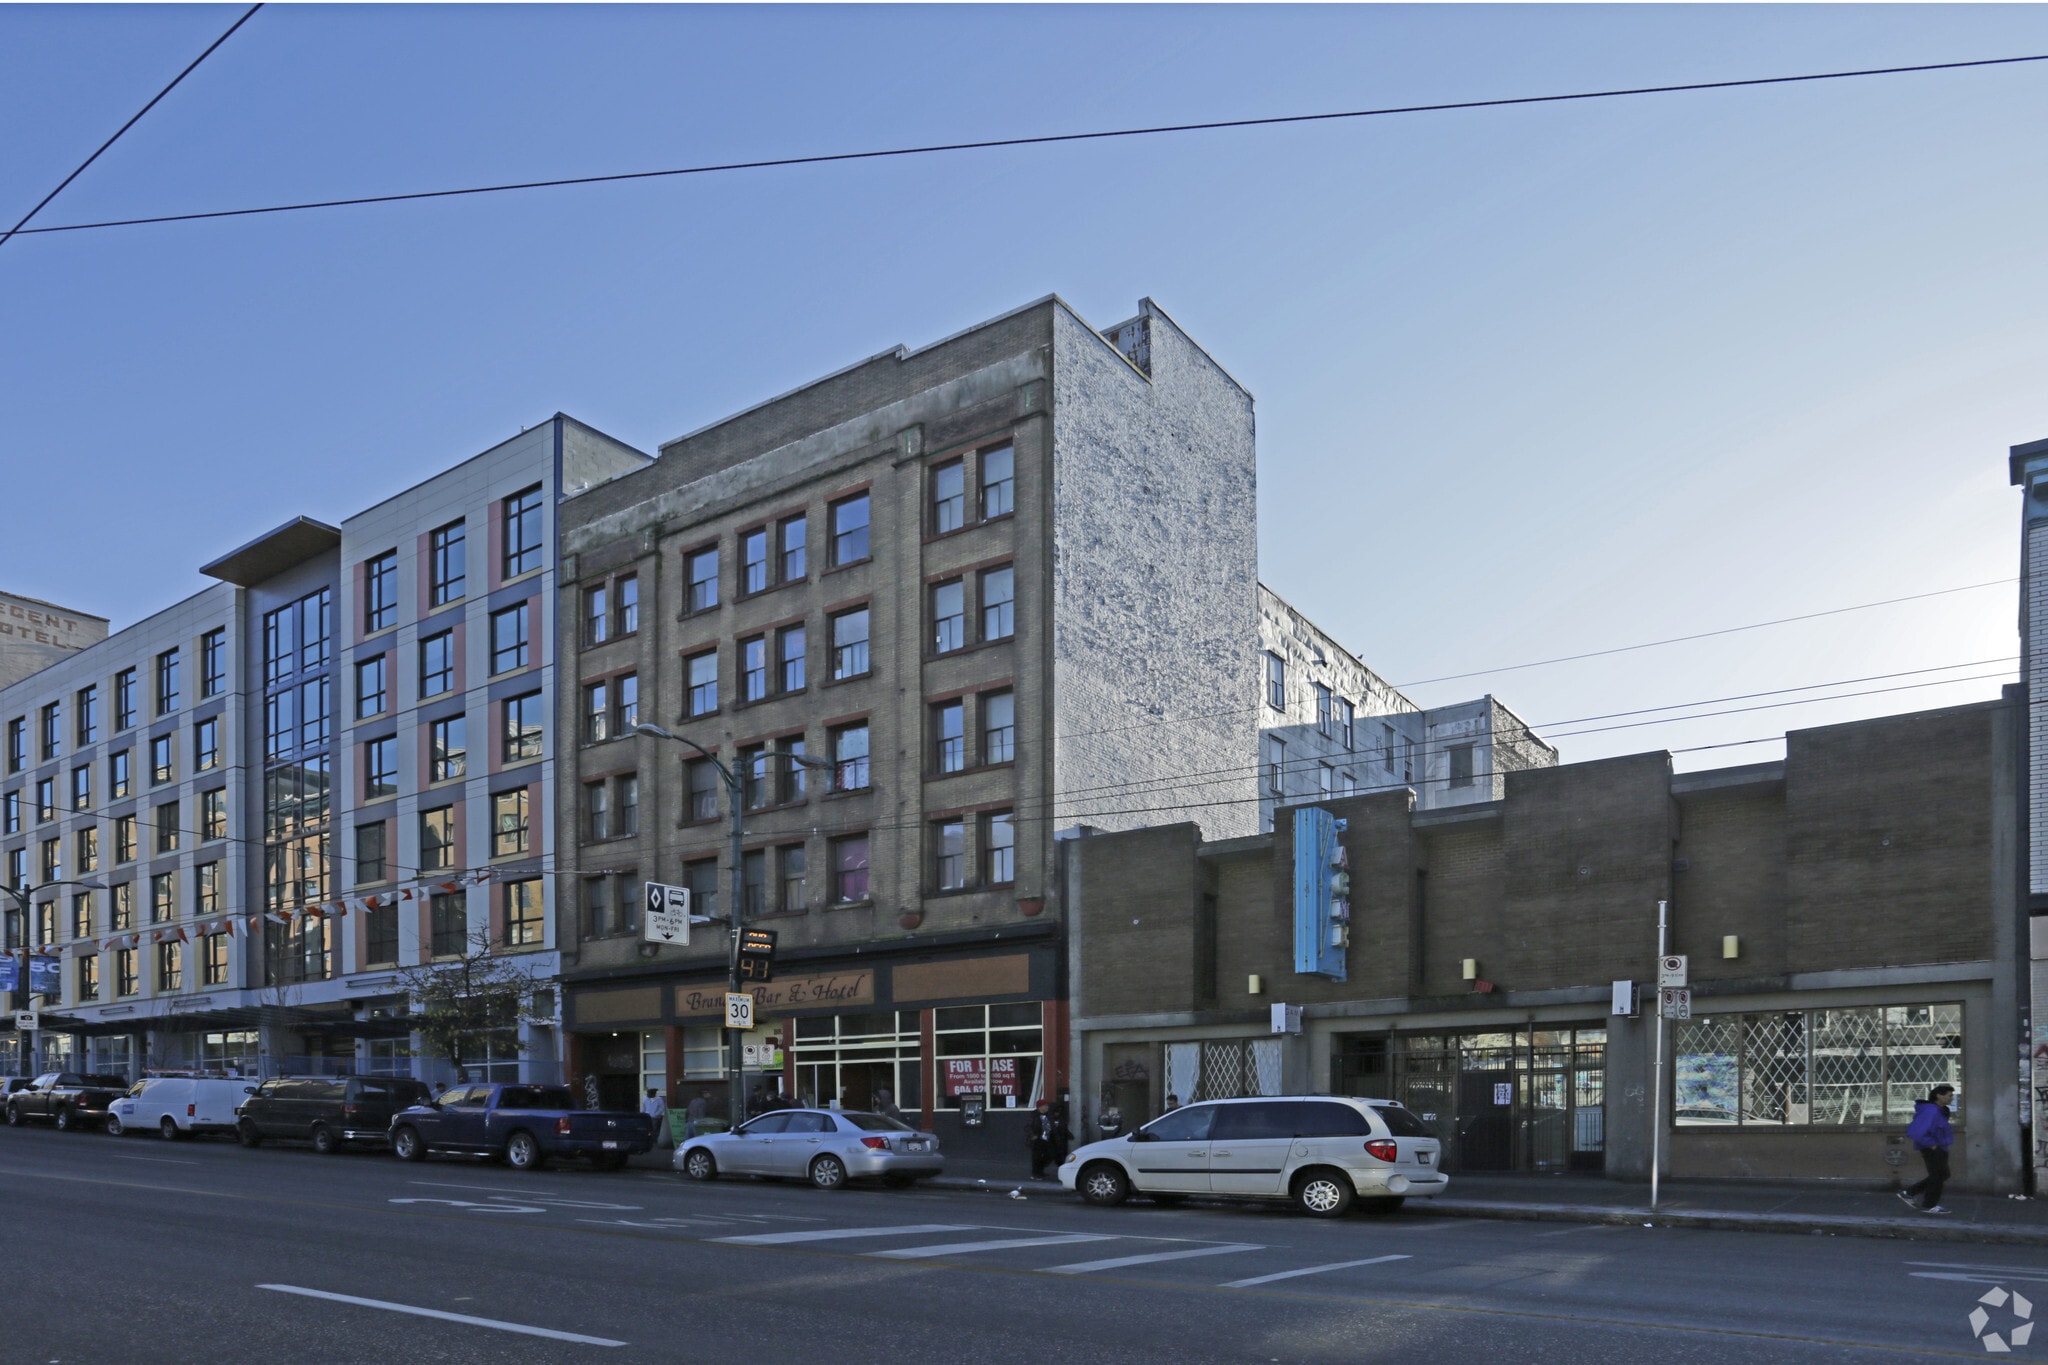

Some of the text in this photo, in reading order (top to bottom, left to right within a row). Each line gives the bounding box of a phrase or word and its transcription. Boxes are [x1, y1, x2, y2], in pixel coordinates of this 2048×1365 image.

[741, 960, 768, 978] 41
[752, 986, 782, 1005] Bar
[812, 974, 865, 999] Hotel
[730, 1003, 749, 1018] 30
[949, 1059, 1014, 1073] FOR LASE
[954, 1085, 971, 1095] 604
[992, 1085, 1013, 1095] 7107
